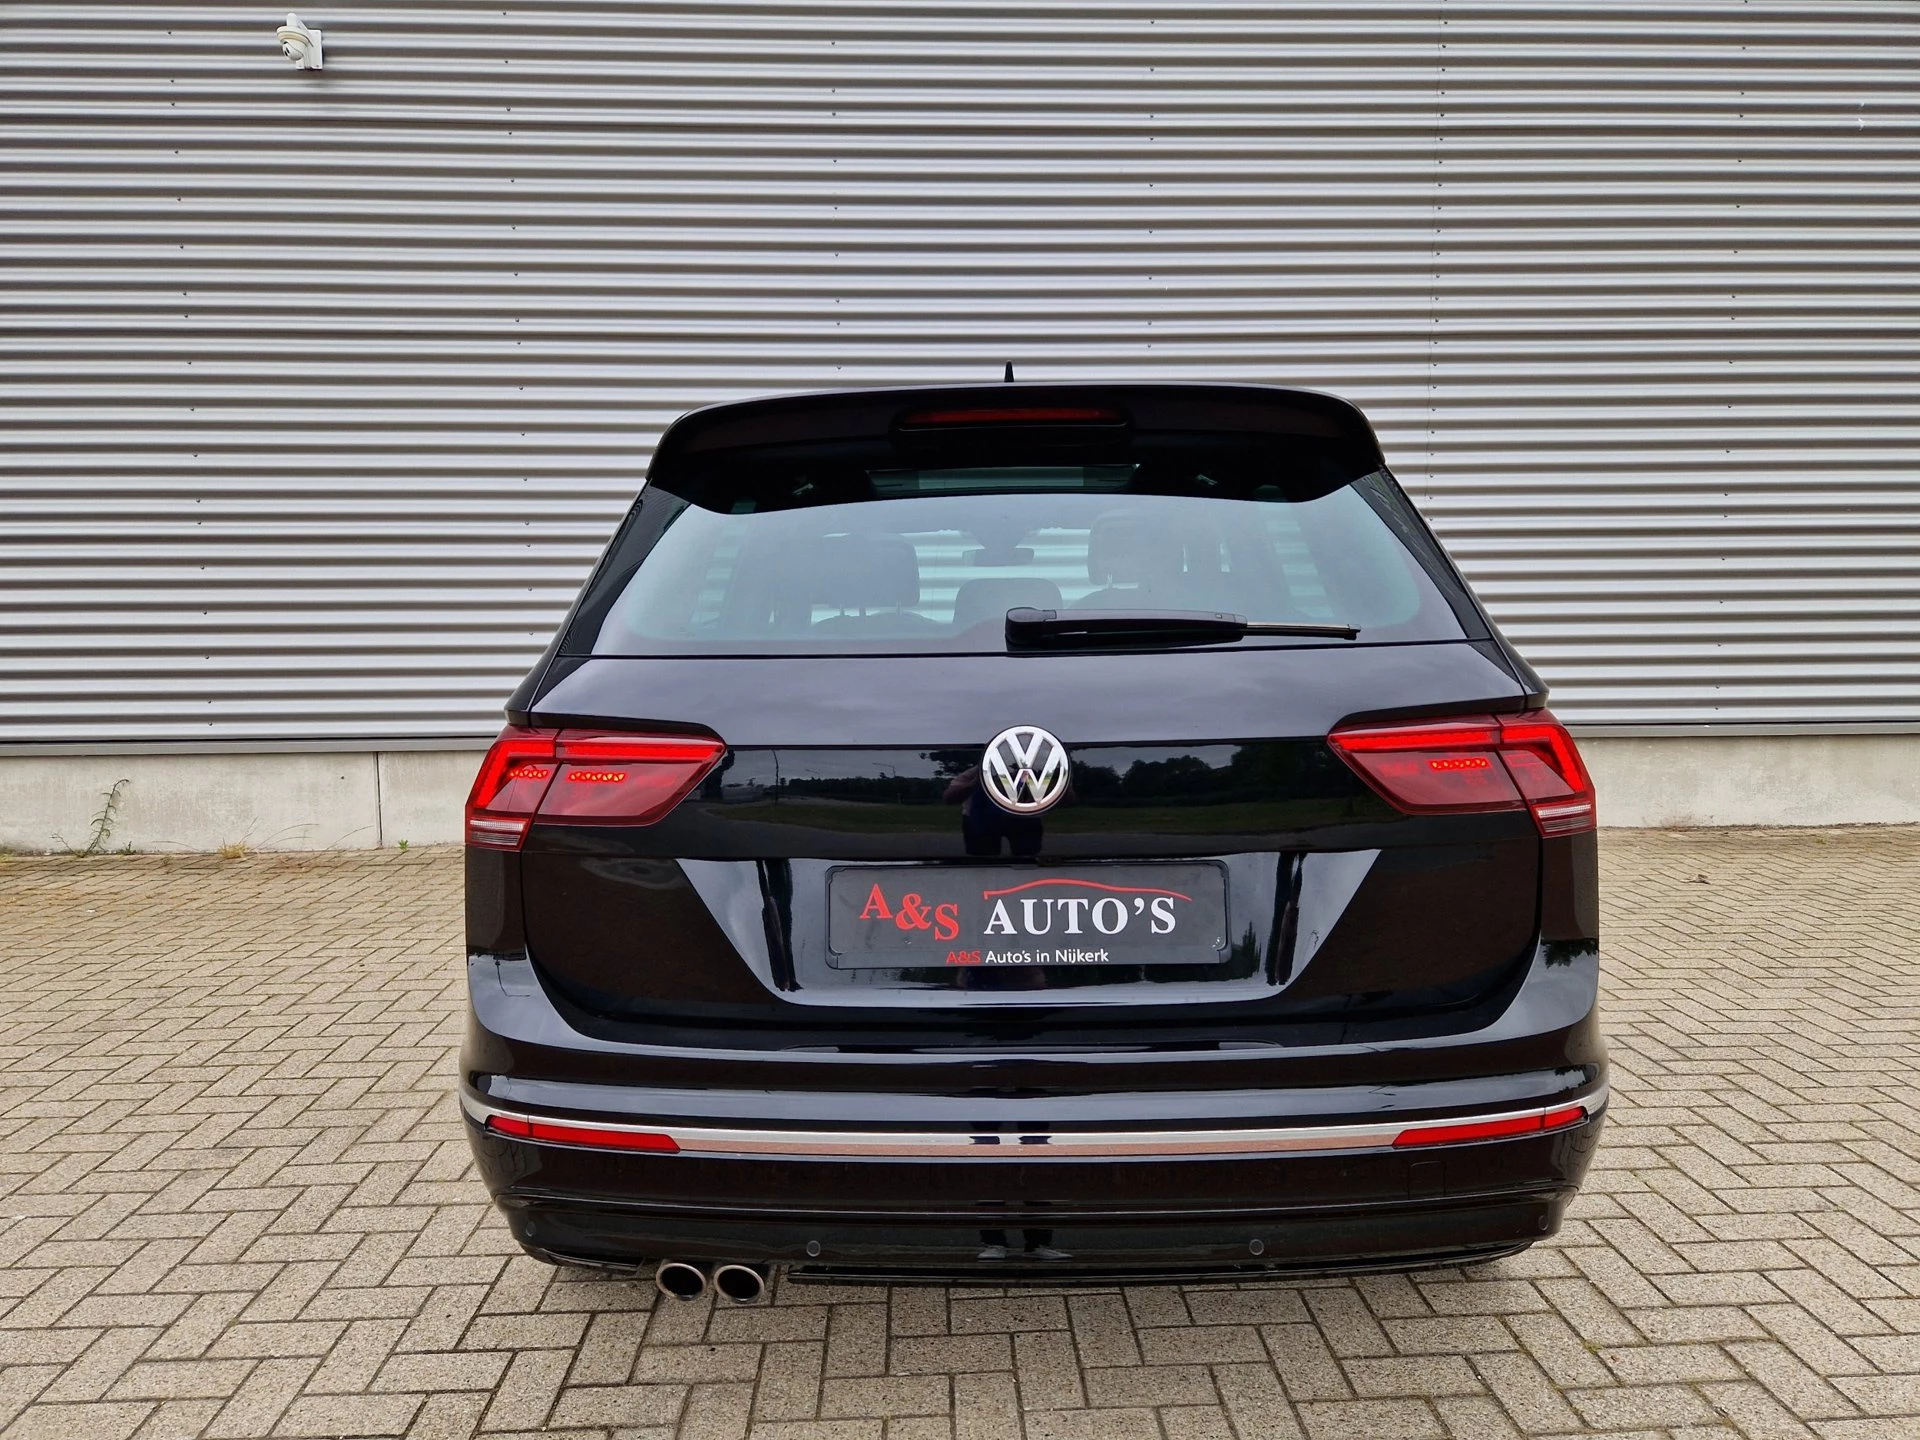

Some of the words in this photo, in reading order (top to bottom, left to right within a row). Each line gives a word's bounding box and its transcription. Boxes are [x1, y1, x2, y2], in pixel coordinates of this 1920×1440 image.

[983, 726, 1068, 812] VW
[860, 883, 959, 940] A&S
[983, 897, 1177, 936] AUTO'S
[945, 950, 982, 964] A&S
[985, 949, 1031, 964] Auto's
[1036, 949, 1050, 963] in
[1055, 948, 1109, 964] Nijkerk
